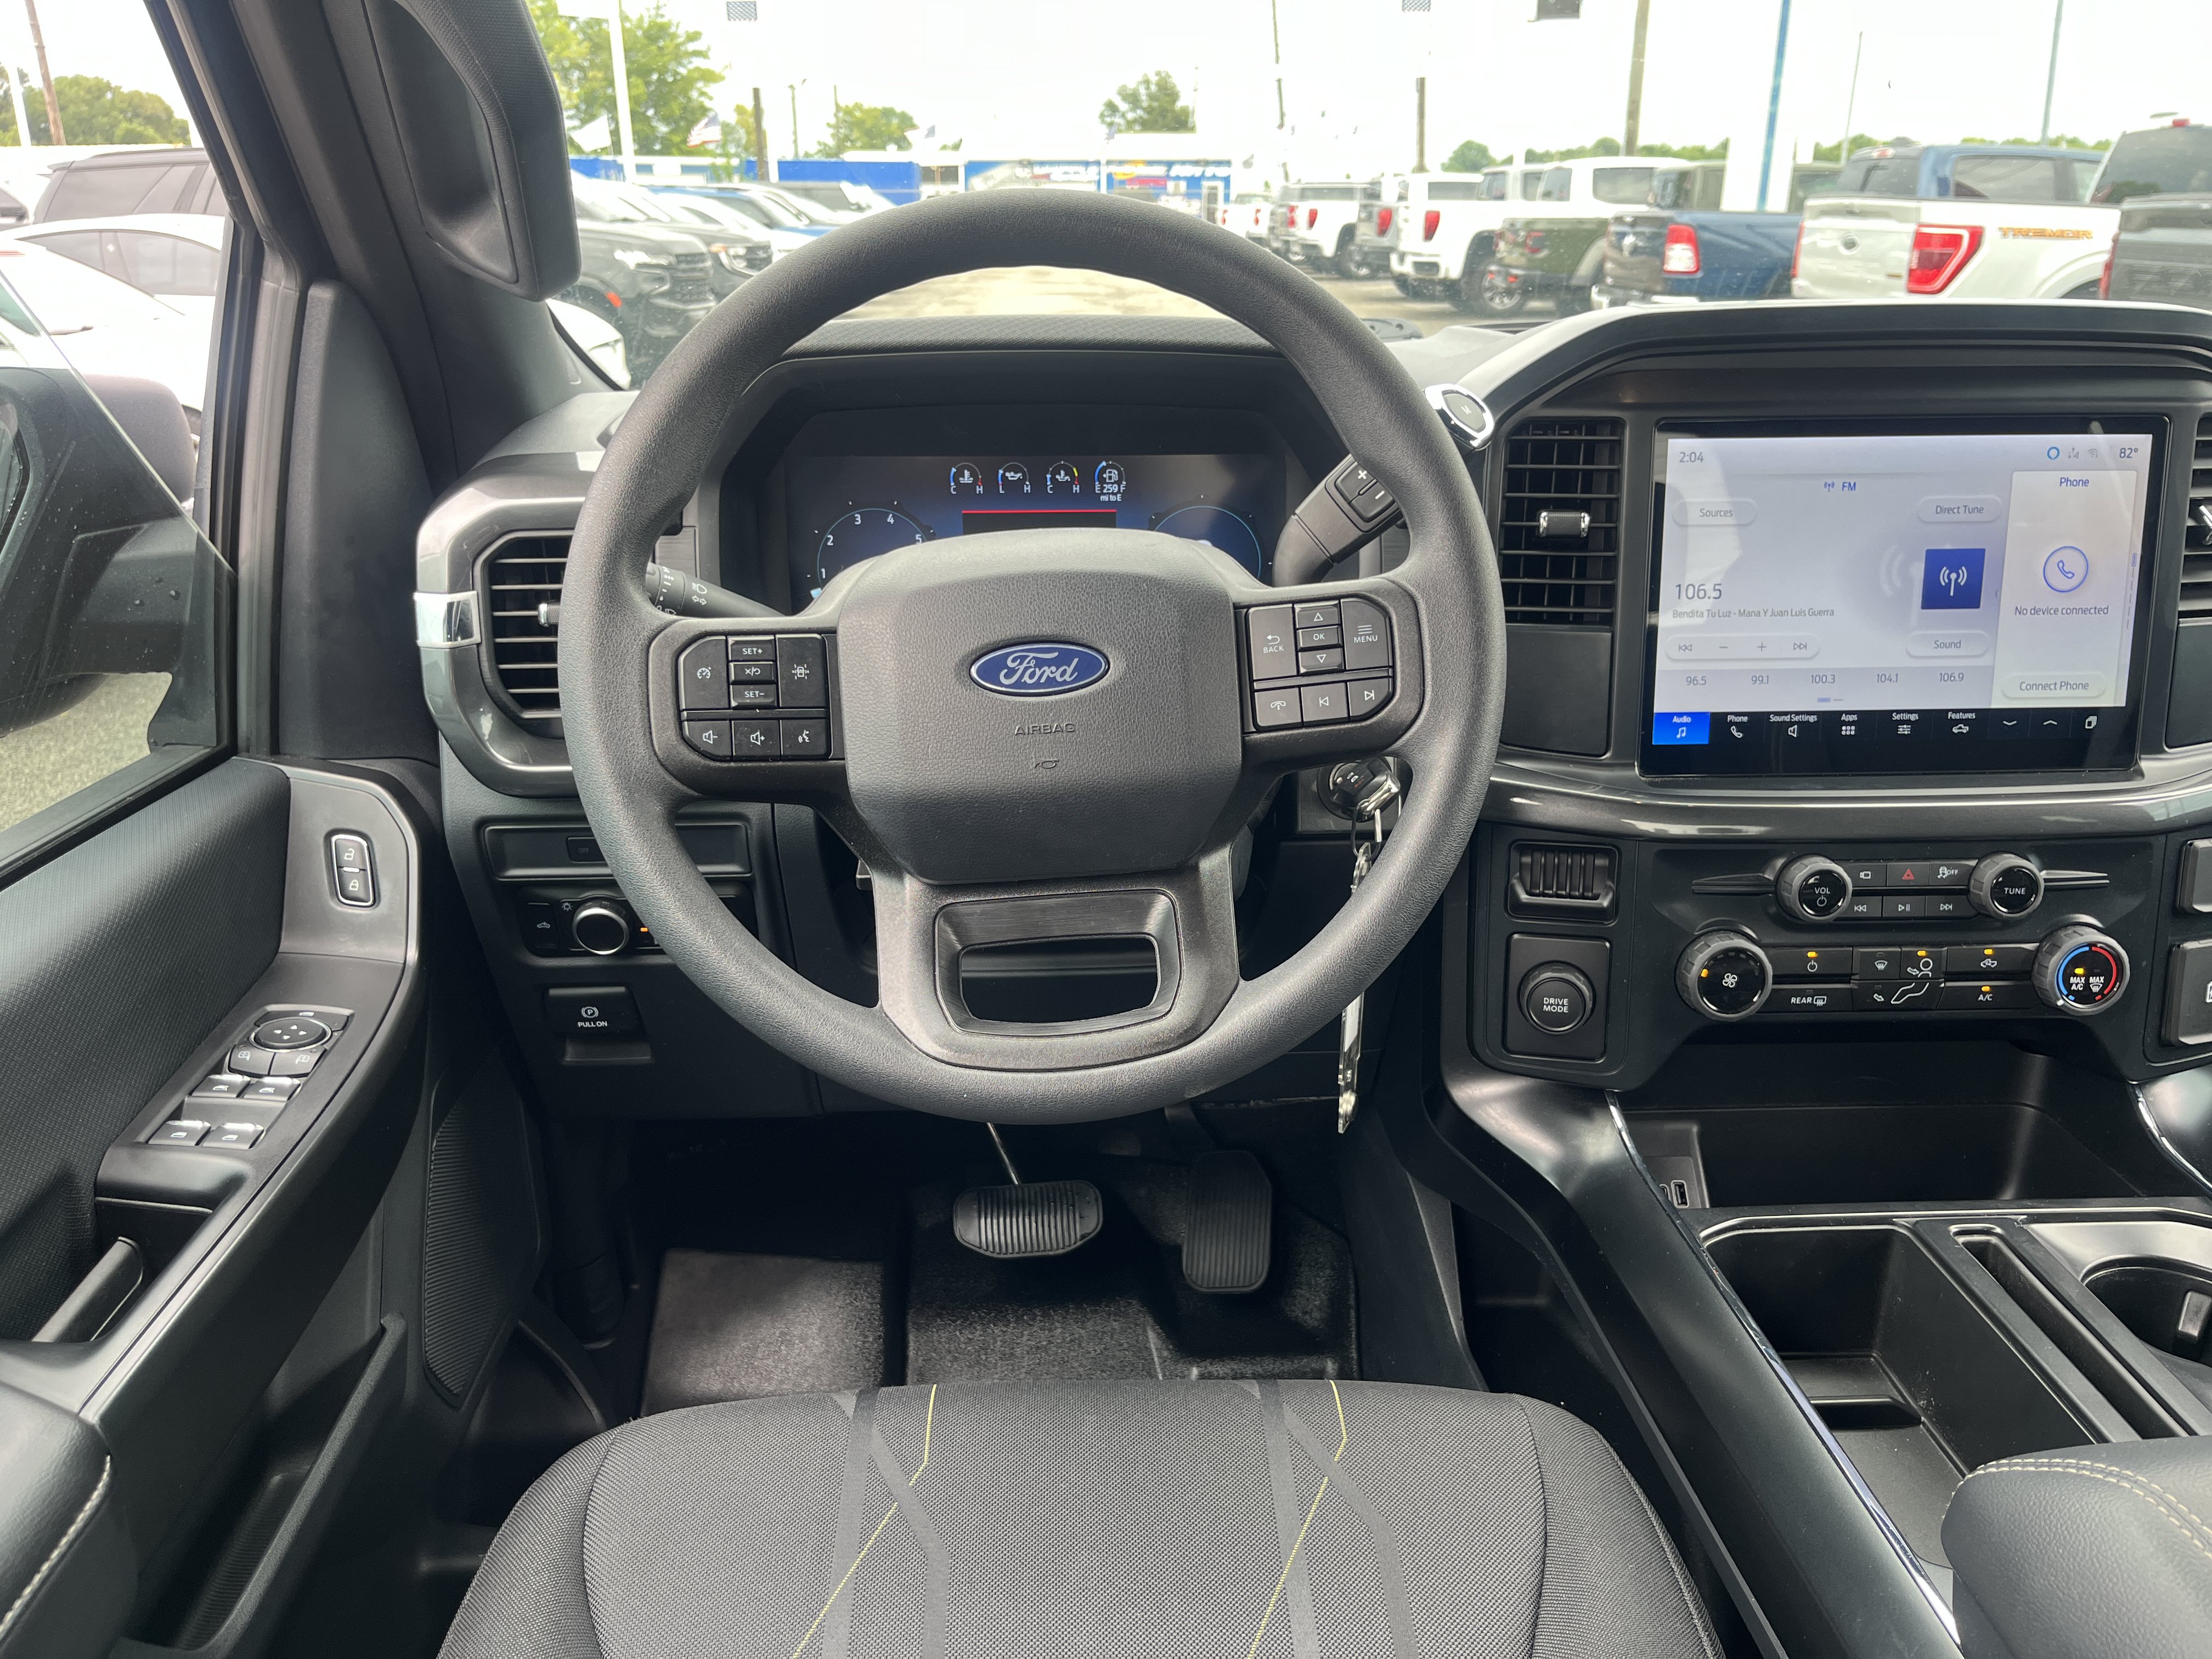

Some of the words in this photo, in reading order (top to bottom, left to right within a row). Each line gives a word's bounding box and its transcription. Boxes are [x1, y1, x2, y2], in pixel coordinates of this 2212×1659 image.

[1997, 227, 2093, 240] TREMOR
[1679, 451, 1705, 464] 2:04
[2118, 447, 2139, 459] 82°
[1841, 481, 1857, 492] FM
[2059, 477, 2090, 488] Phone
[950, 485, 957, 494] C
[976, 485, 983, 494] H
[999, 485, 1005, 493] L
[1024, 484, 1031, 493] H
[1047, 485, 1053, 494] C
[1073, 485, 1080, 493] H
[1094, 484, 1101, 493] E
[1103, 484, 1119, 493] 259
[1120, 484, 1126, 493] F
[1699, 507, 1734, 518] Sources
[1935, 504, 1961, 515] Direct
[1962, 504, 1984, 515] Tune
[854, 514, 861, 525] 3
[887, 514, 895, 524] 4
[827, 534, 834, 546] 2
[915, 534, 922, 544] 5
[821, 568, 826, 579] 1
[1675, 583, 1723, 600] 106.5
[1672, 609, 1705, 618] Bendita
[1706, 609, 1717, 618] Tu
[1717, 609, 1731, 618] Luz
[1738, 608, 1761, 617] Mana
[1762, 608, 1769, 617] Y
[1769, 608, 1788, 617] Juan
[1790, 608, 1807, 617] Luis
[1808, 607, 1835, 617] Guerra
[2015, 606, 2028, 616] No
[2029, 605, 2059, 616] device
[2061, 605, 2109, 615] connected
[1313, 633, 1325, 641] OK
[1353, 634, 1378, 644] MENU
[1933, 639, 1962, 649] Sound
[1262, 645, 1284, 654] BACK
[999, 651, 1079, 685] Ford
[1685, 675, 1707, 686] 96.5
[1751, 675, 1770, 685] 99.1
[1810, 674, 1836, 684] 100.3
[1876, 673, 1899, 683] 104.1
[1939, 672, 1965, 682] 106.9
[2019, 681, 2057, 691] Connect
[2059, 680, 2089, 691] Phone
[1672, 715, 1691, 723] Audio
[1727, 714, 1748, 723] Phone
[1769, 714, 1791, 723] Sound
[1791, 714, 1818, 723] Settings
[1841, 713, 1858, 722] Apps
[1892, 712, 1919, 721] Settings
[1947, 711, 1976, 720] Features
[1014, 722, 1076, 736] AIRBAG
[1946, 868, 1959, 876] OFF
[1814, 887, 1831, 895] VOL
[2004, 887, 2026, 895] TUNE
[1543, 997, 1568, 1005] DRIVE
[1791, 996, 1812, 1005] REAR
[1978, 994, 1993, 1002] A/C
[1543, 1005, 1568, 1013] MODE
